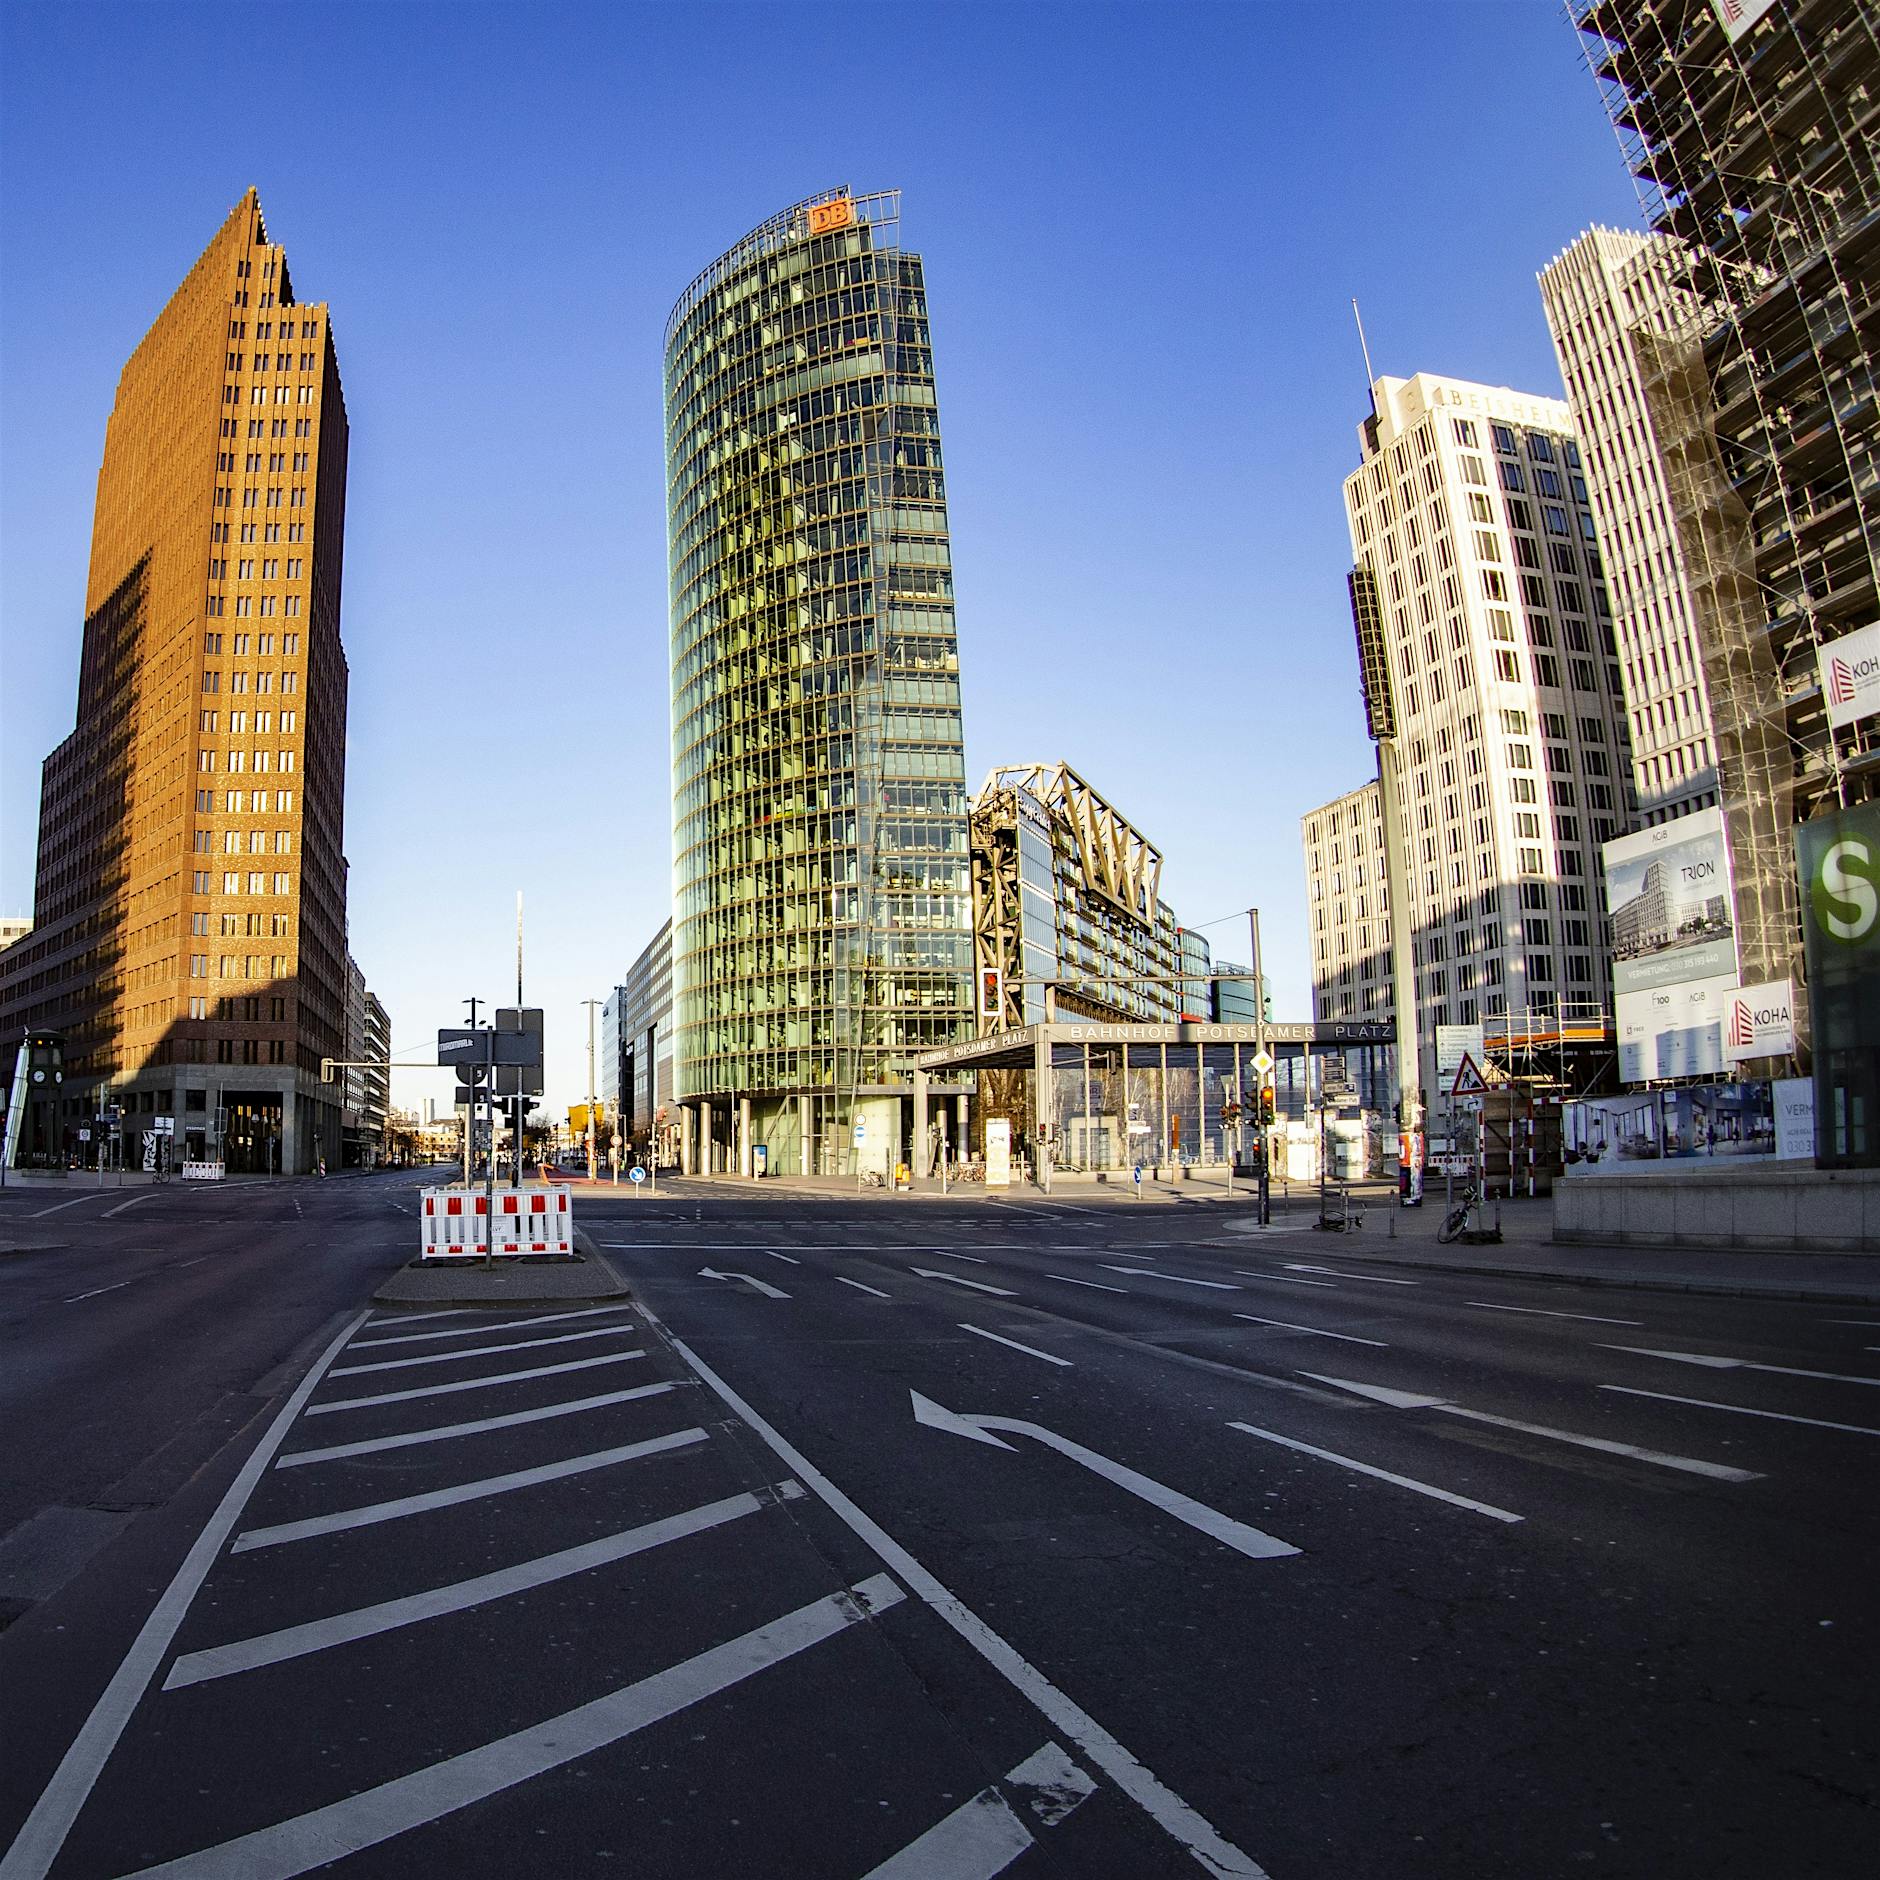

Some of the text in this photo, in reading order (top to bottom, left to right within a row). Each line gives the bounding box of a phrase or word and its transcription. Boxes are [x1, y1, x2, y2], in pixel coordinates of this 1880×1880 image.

[814, 203, 847, 229] DB
[1450, 390, 1571, 427] BEISHEIM
[1681, 859, 1715, 883] TRION
[1821, 840, 1878, 939] S
[1753, 1007, 1790, 1026] KOHA
[1071, 1026, 1175, 1039] BAHNHOF
[1335, 1025, 1391, 1038] PLATZ
[919, 1030, 1029, 1065] BAHNHOF POTSDAMER PLATZ
